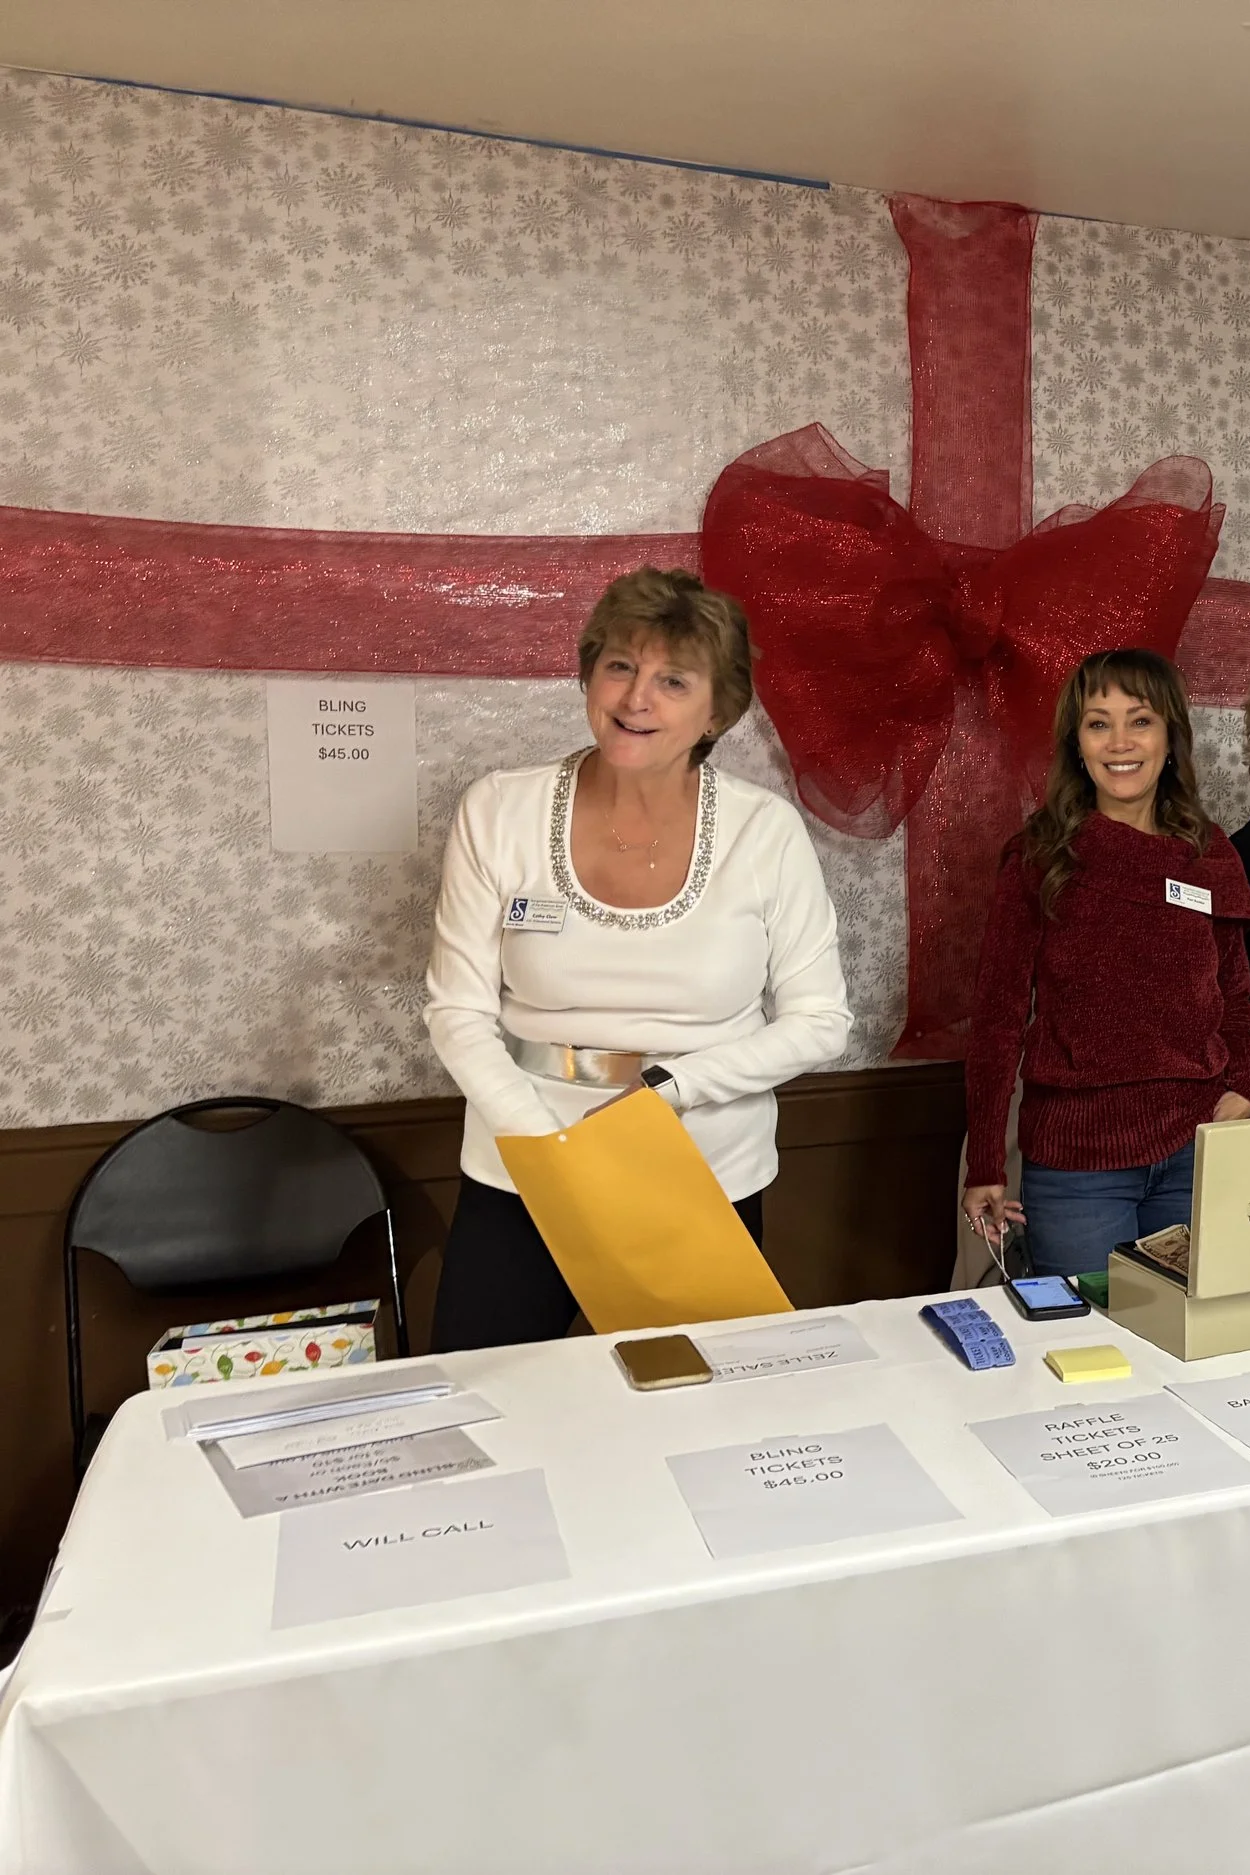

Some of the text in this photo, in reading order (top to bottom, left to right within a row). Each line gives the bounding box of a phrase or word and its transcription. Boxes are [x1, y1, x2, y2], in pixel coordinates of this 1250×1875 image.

[318, 699, 367, 713] BLING
[311, 723, 375, 737] TICKETS
[318, 747, 370, 760] $45.00
[777, 1351, 839, 1366] ZELLE
[1045, 1413, 1125, 1432] RAFFLE
[1051, 1425, 1141, 1445] TICKETS
[750, 1445, 822, 1461] BLING
[1040, 1434, 1179, 1461] SHEET OF 25
[744, 1456, 843, 1476] TICKETS
[1087, 1451, 1161, 1470] $20.00
[763, 1470, 843, 1489] $45.00
[343, 1519, 495, 1550] WILL CALL
